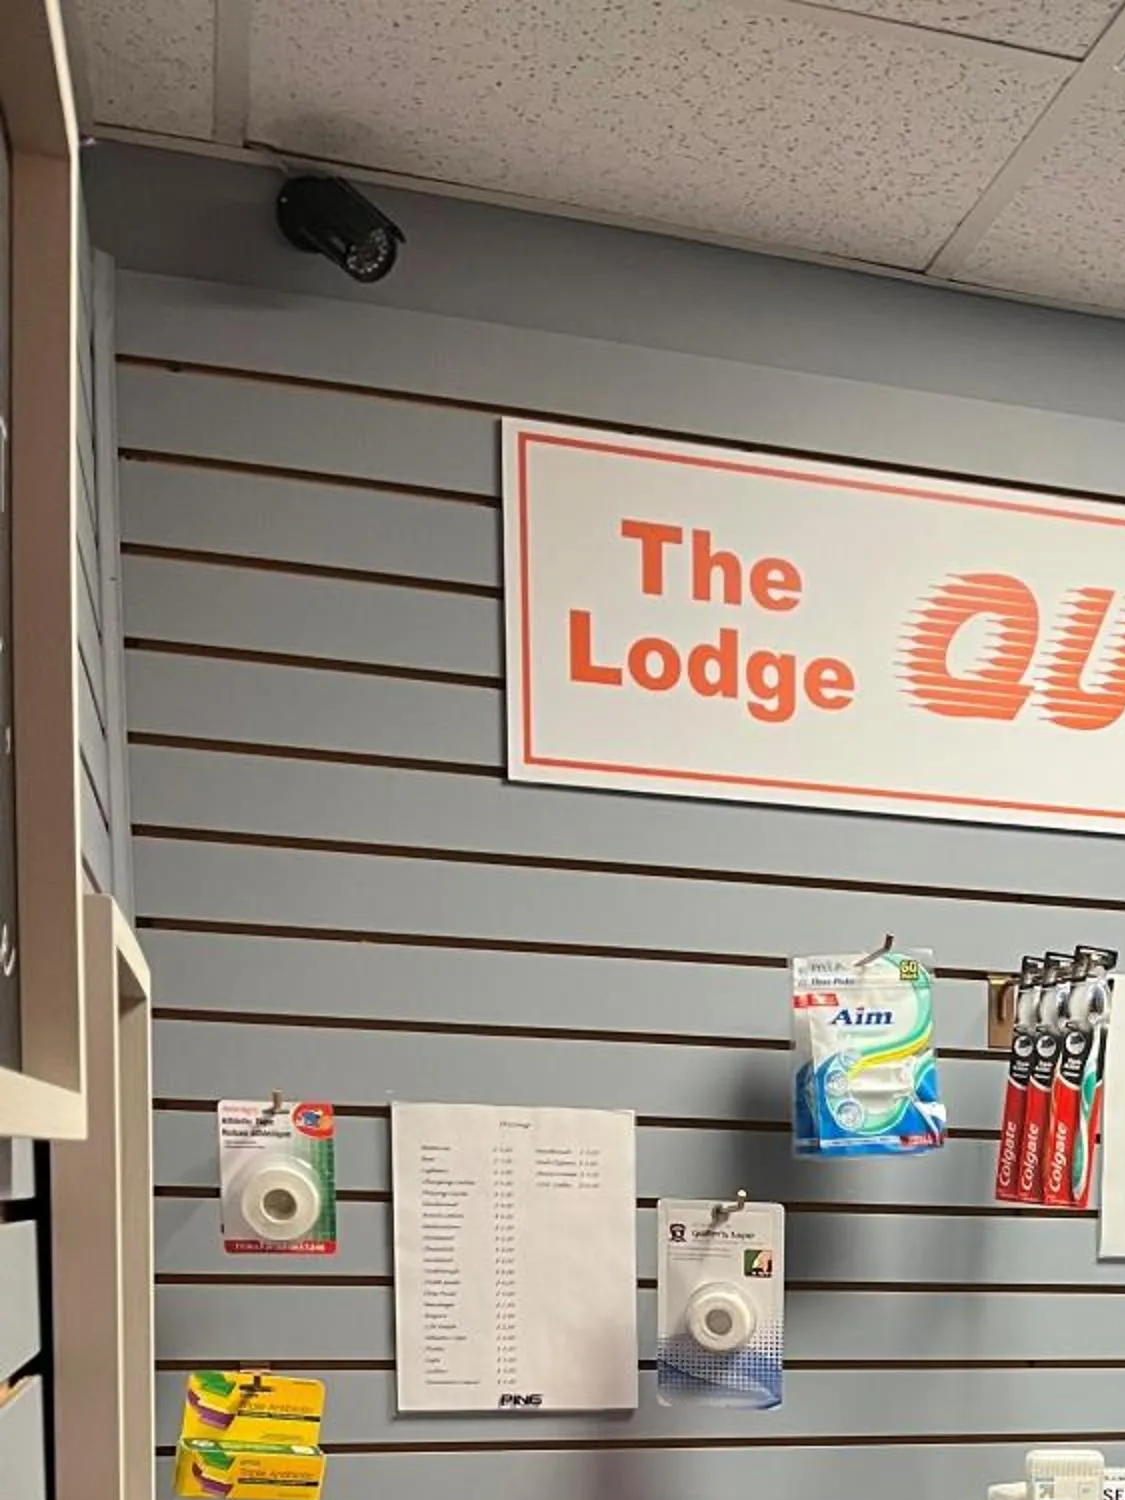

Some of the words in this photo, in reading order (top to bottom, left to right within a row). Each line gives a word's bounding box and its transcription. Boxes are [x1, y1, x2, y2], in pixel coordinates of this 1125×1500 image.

[620, 519, 802, 612] The
[568, 608, 855, 723] Lodge
[831, 1006, 895, 1026] Aim
[1000, 1121, 1018, 1187] Colgate
[1022, 1122, 1039, 1192] Colgate
[1050, 1121, 1067, 1193] Colgate
[500, 1393, 543, 1406] PING
